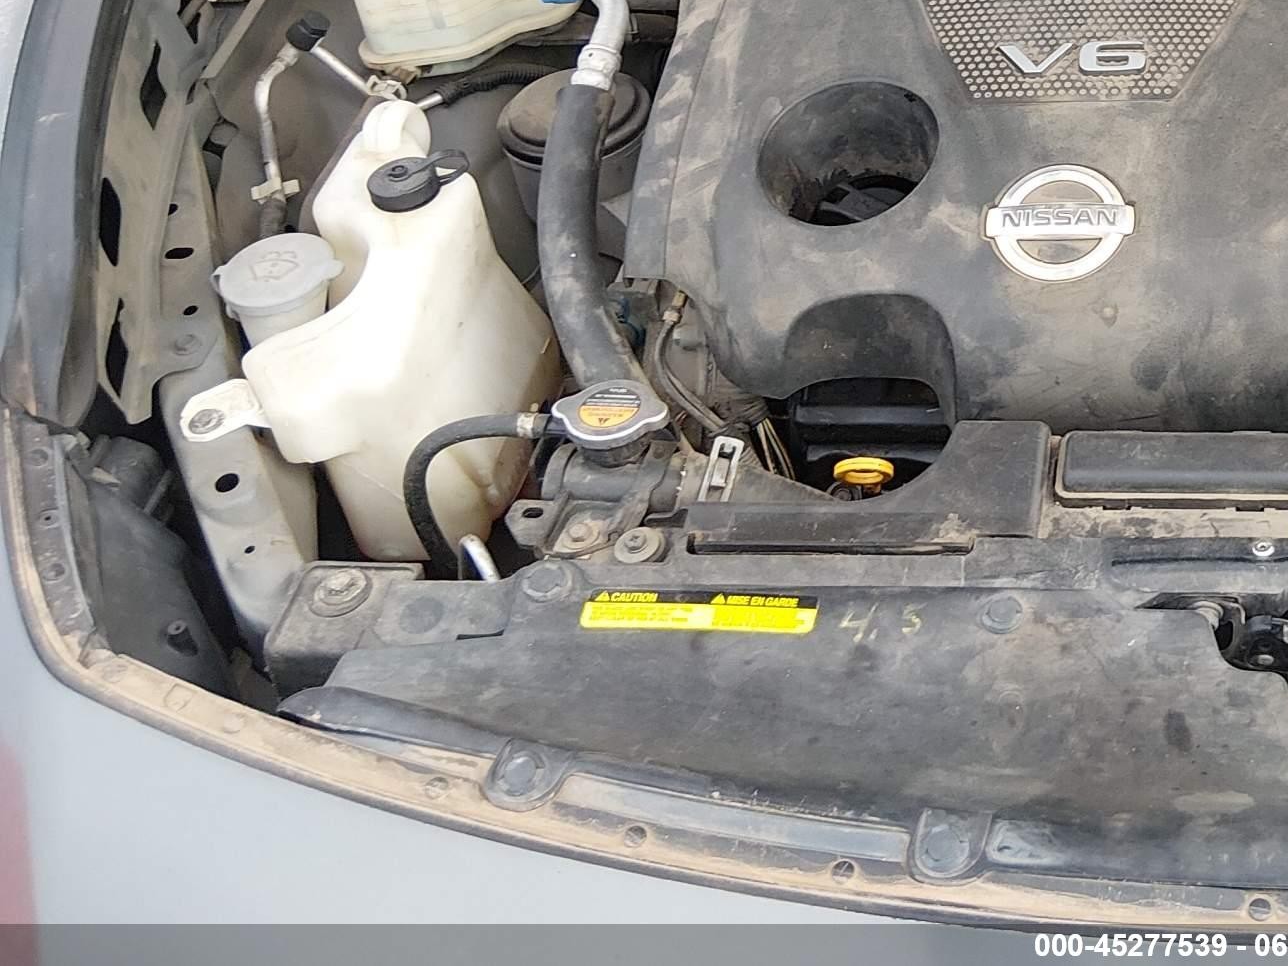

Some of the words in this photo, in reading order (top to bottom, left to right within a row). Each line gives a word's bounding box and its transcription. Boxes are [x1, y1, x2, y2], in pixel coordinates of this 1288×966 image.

[996, 41, 1147, 75] V6
[1001, 207, 1118, 229] NISSAN
[611, 592, 659, 603] CAUTION
[726, 595, 752, 606] MISE
[764, 597, 800, 608] GARDE
